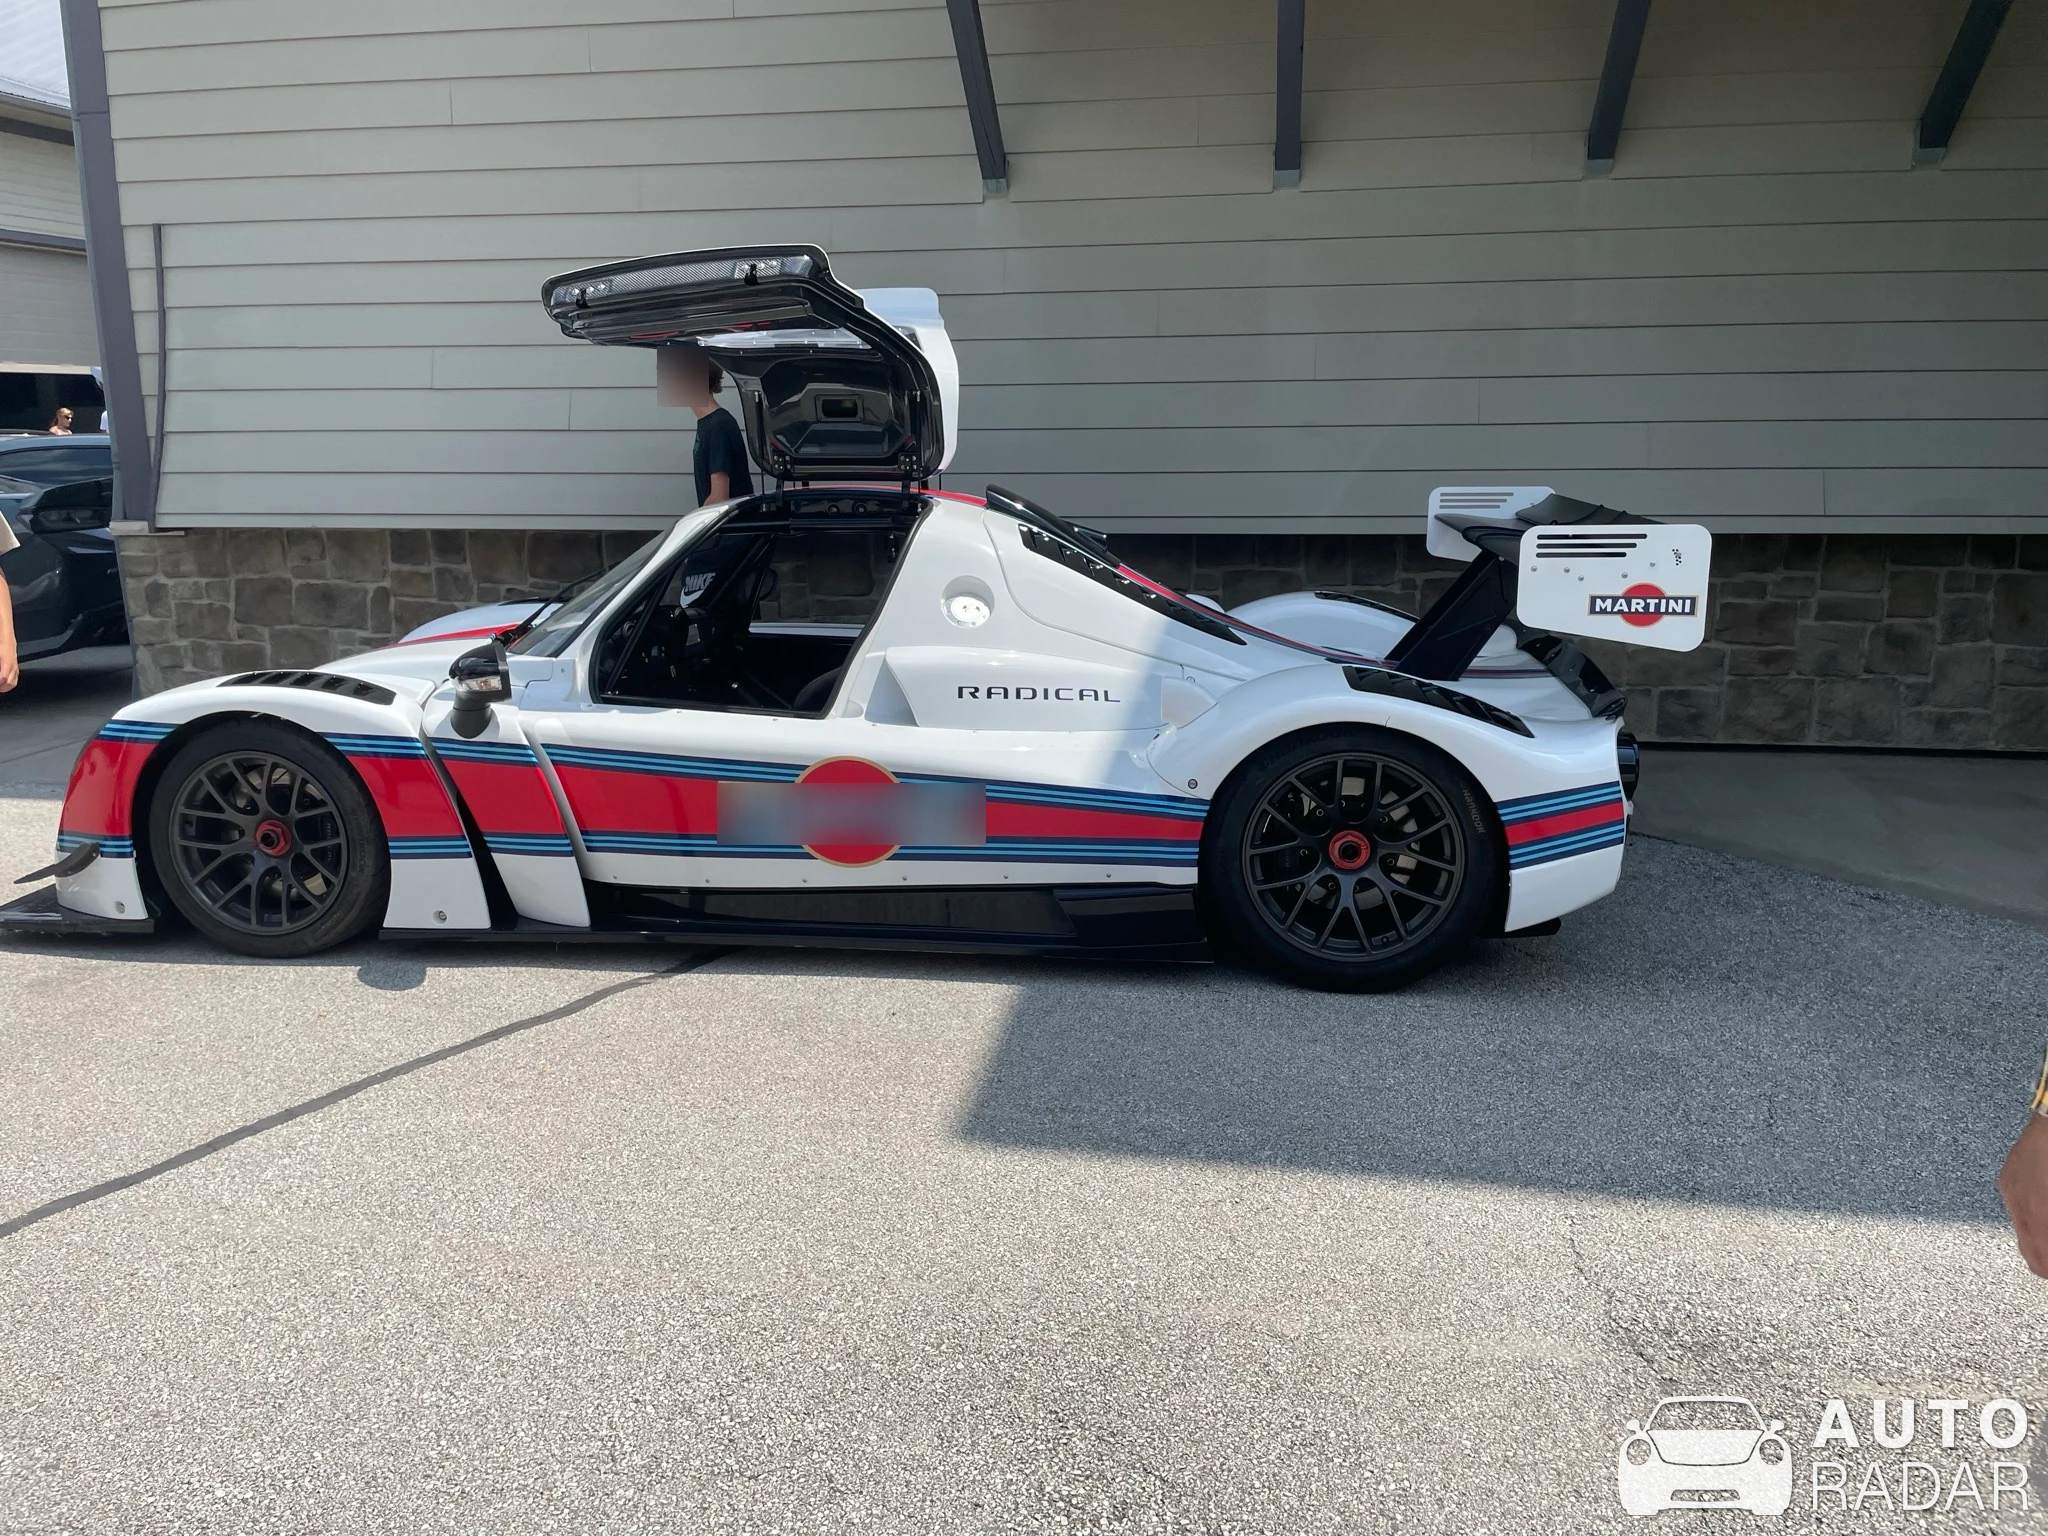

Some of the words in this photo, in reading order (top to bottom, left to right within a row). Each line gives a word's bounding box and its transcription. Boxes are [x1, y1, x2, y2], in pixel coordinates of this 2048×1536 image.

[685, 572, 716, 593] NIKE
[1595, 597, 1692, 614] MARTINI
[957, 685, 1121, 703] RADICAL
